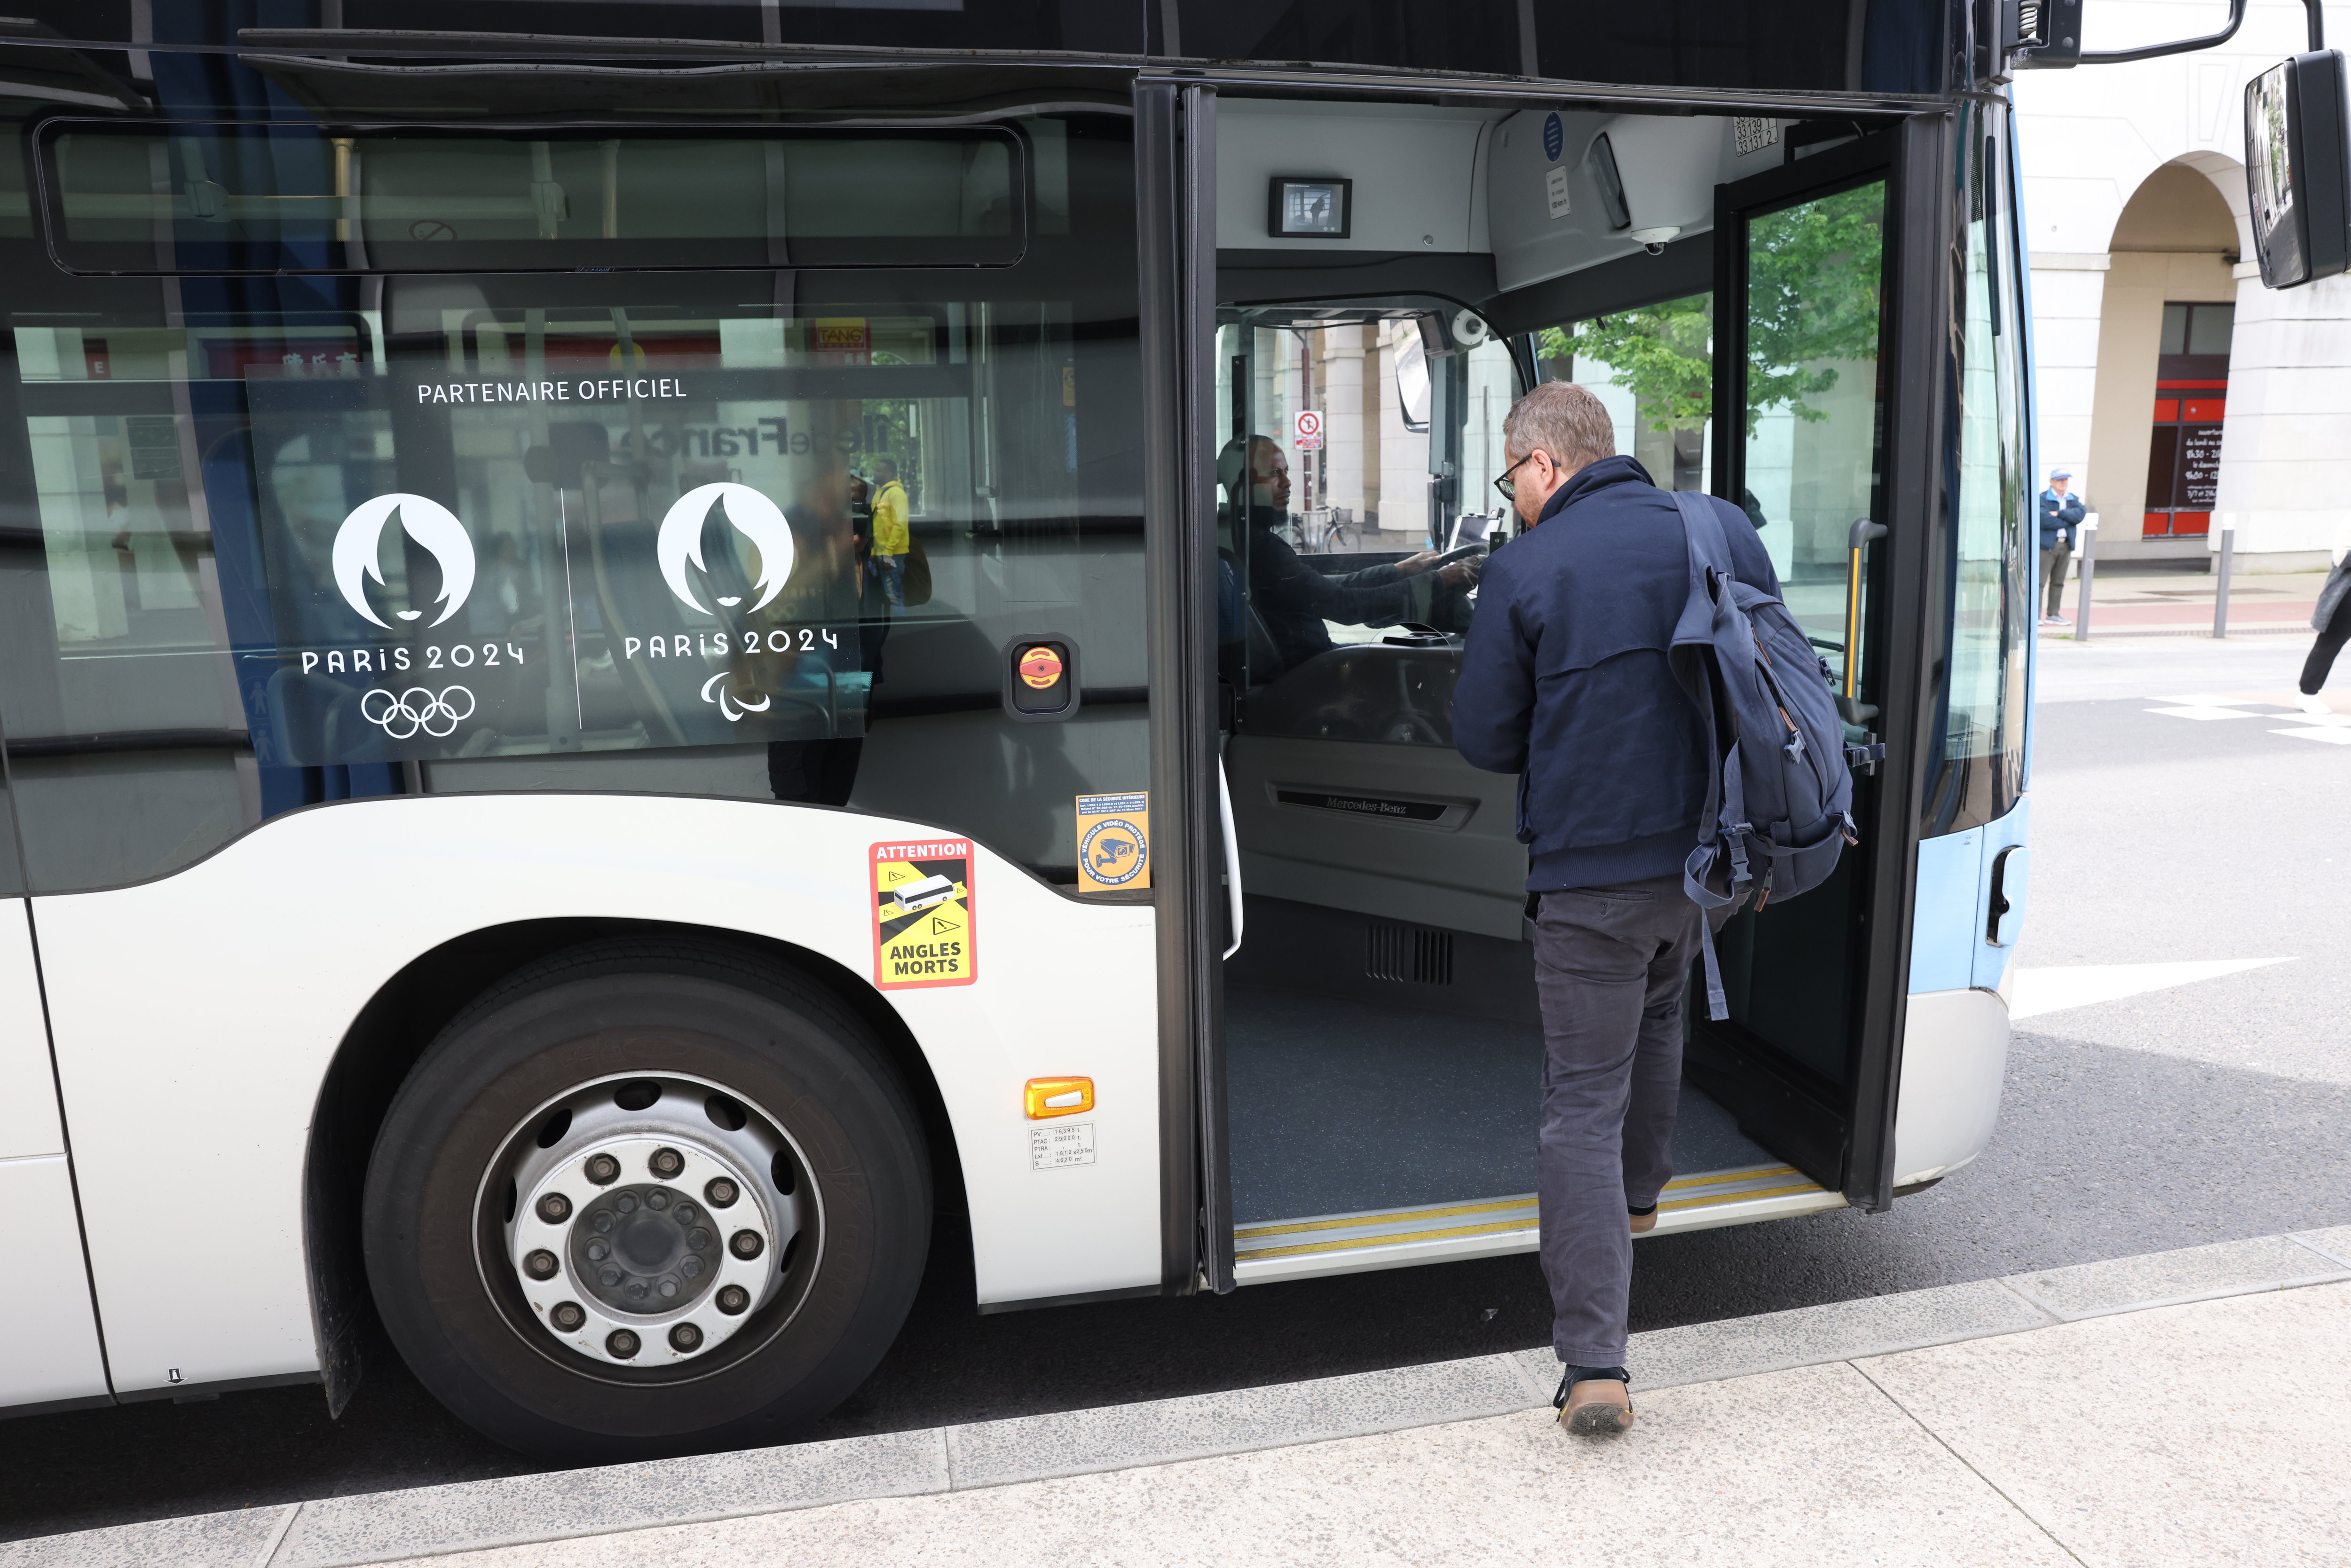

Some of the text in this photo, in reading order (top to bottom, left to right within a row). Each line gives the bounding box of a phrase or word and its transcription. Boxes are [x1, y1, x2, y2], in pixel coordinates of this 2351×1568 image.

[1737, 124, 1746, 139] 33
[1748, 118, 1761, 135] 139
[1739, 130, 1772, 154] 33 131 2
[819, 329, 863, 342] TANG
[418, 378, 686, 403] PARTENAIRE OFFICIEL
[744, 629, 837, 654] 2024
[426, 643, 524, 669] 2024
[1326, 797, 1407, 815] Mercedes-Benz
[1081, 824, 1103, 853] VÉHICULE
[1124, 823, 1146, 849] PROTÉGÉ
[876, 843, 967, 859] ATTENTION
[1083, 853, 1144, 883] POUR VOTRE SÉCURITÉ
[890, 942, 961, 960] ANGLES
[895, 958, 959, 976] MORTS
